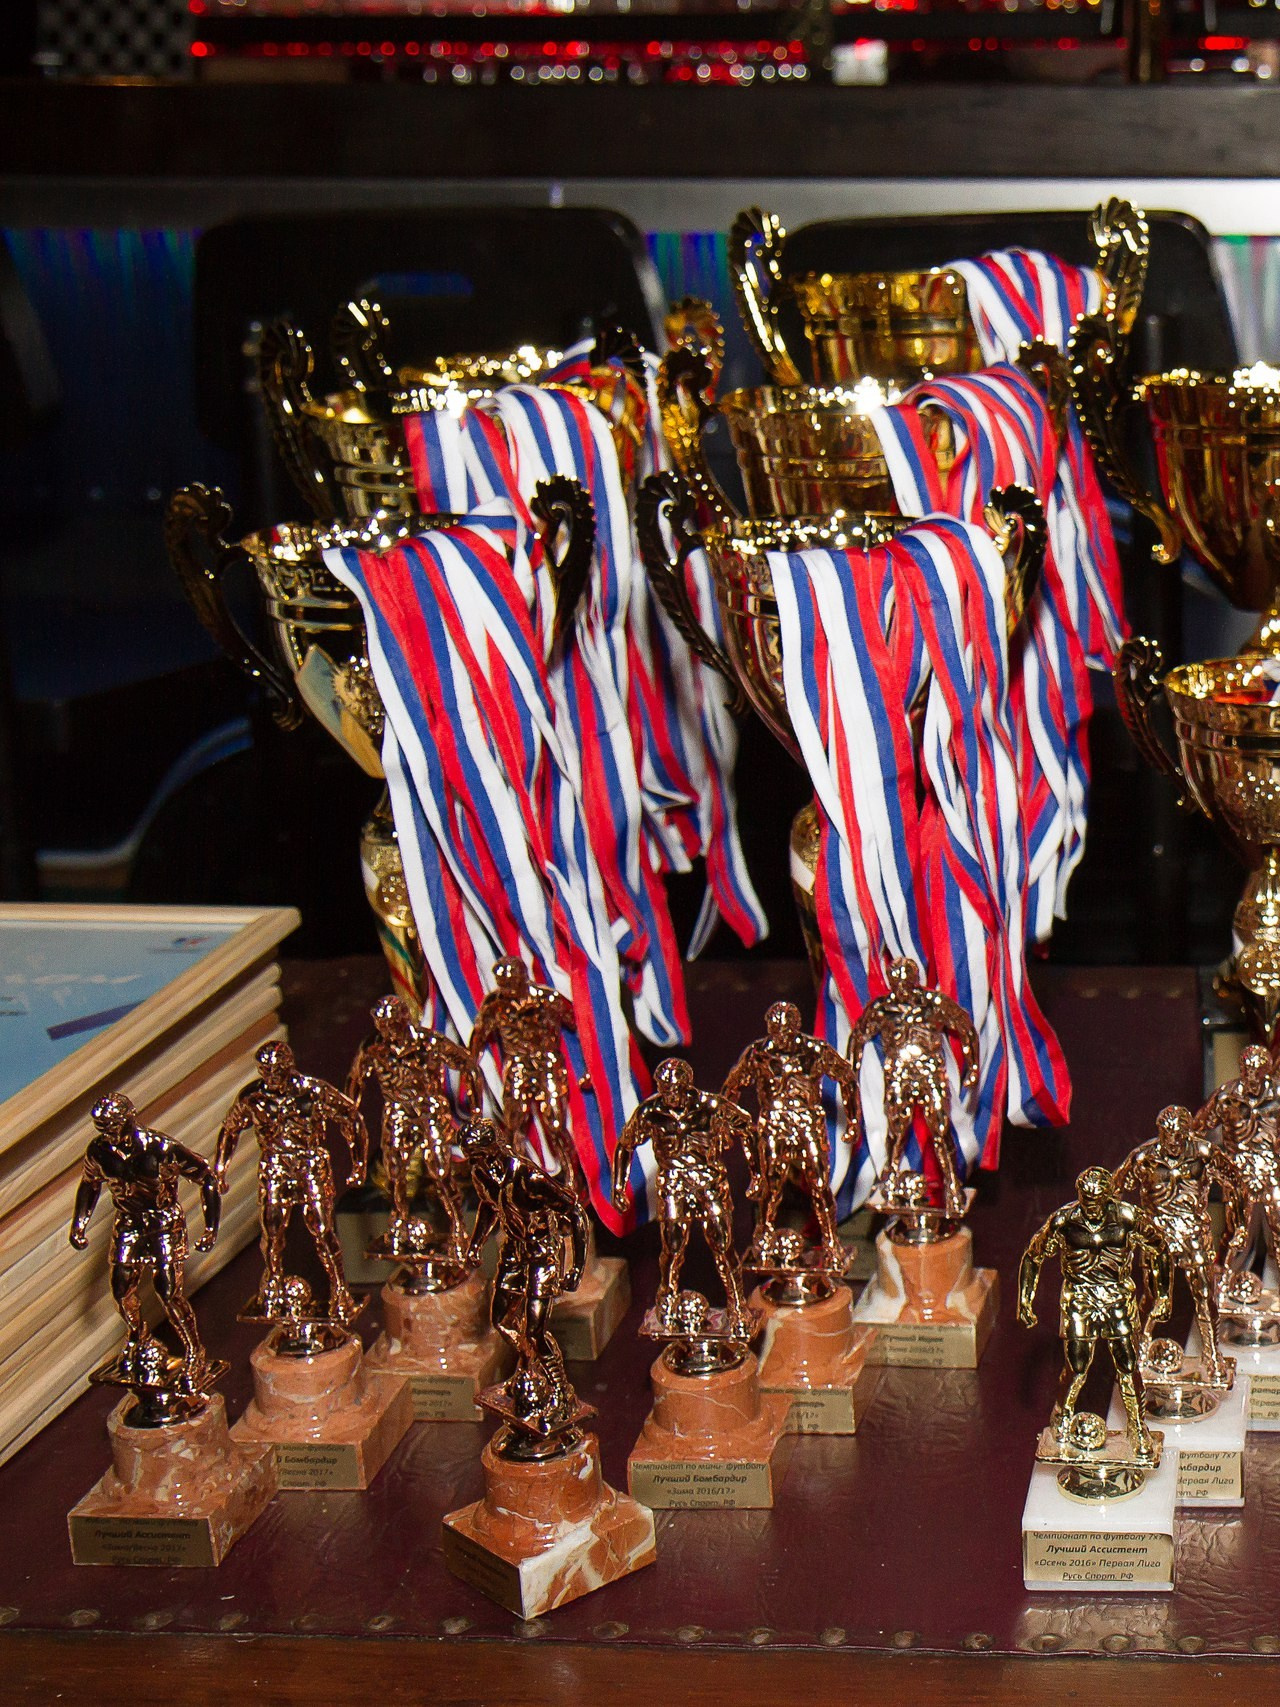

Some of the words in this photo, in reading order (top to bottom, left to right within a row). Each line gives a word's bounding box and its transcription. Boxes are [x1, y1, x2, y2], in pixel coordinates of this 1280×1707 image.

[633, 1463, 683, 1471] Чемпионат
[652, 1474, 690, 1483] Лучший
[692, 1474, 748, 1483] Бомбардир
[1211, 1477, 1234, 1485] Лига
[1103, 1533, 1146, 1541] футболу
[1046, 1545, 1087, 1554] Лучший
[1089, 1545, 1148, 1554] Ассистент
[1034, 1559, 1067, 1567] «Осень
[1069, 1559, 1097, 1567] 2016»
[1099, 1559, 1135, 1568] Первая
[1137, 1559, 1161, 1568] Лига
[1062, 1572, 1082, 1581] Русь
[1084, 1572, 1118, 1581] Спорт.
[1120, 1572, 1134, 1580] РФ
